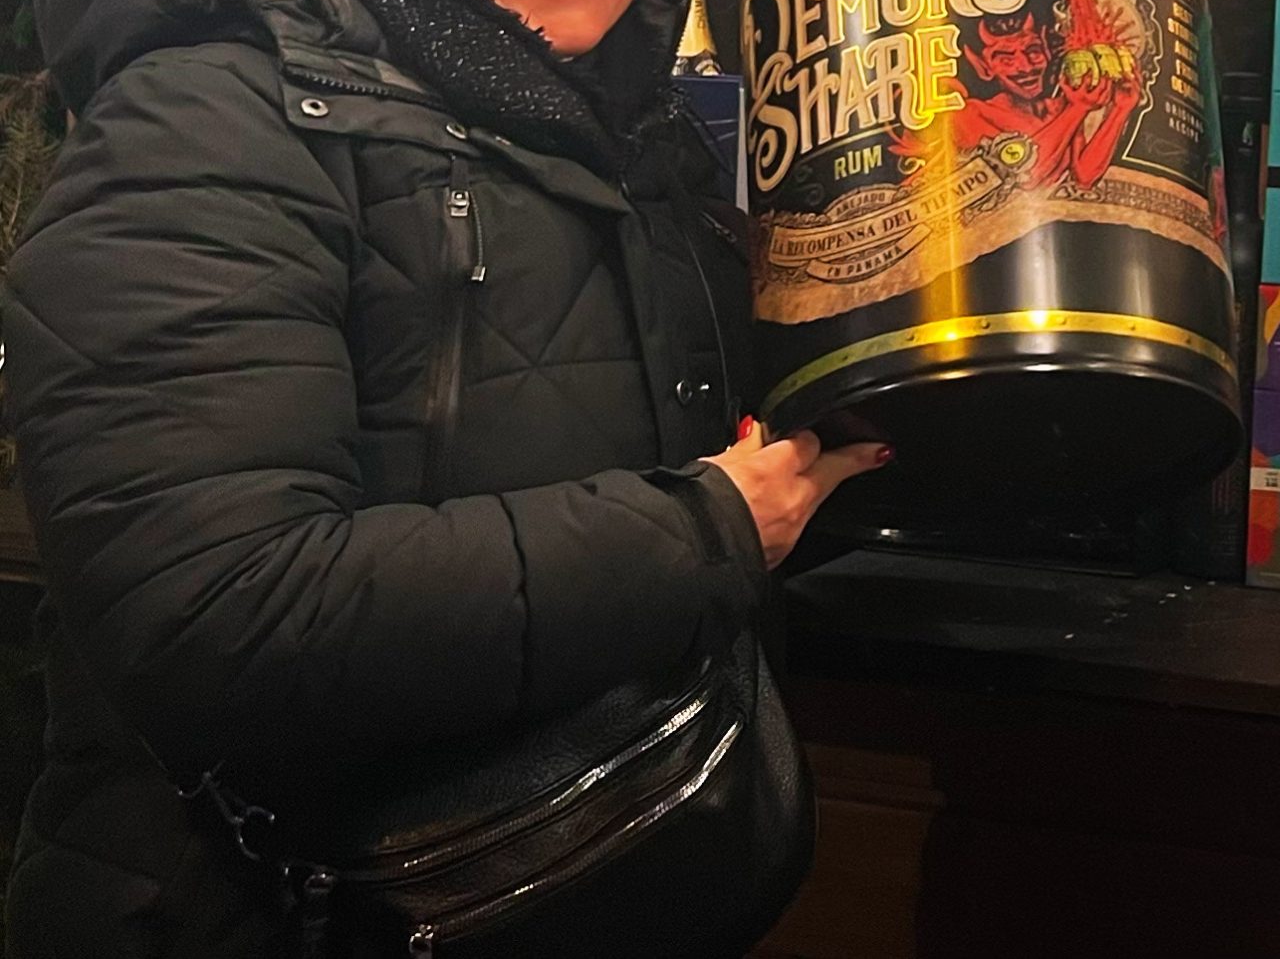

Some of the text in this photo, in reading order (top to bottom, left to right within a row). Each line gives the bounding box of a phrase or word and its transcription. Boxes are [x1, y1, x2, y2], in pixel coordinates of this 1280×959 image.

[748, 24, 967, 192] SHARE
[834, 144, 883, 180] RUM
[786, 222, 876, 256] RECOMPENSA
[882, 209, 918, 232] DEL
[846, 246, 903, 277] PANAMA
